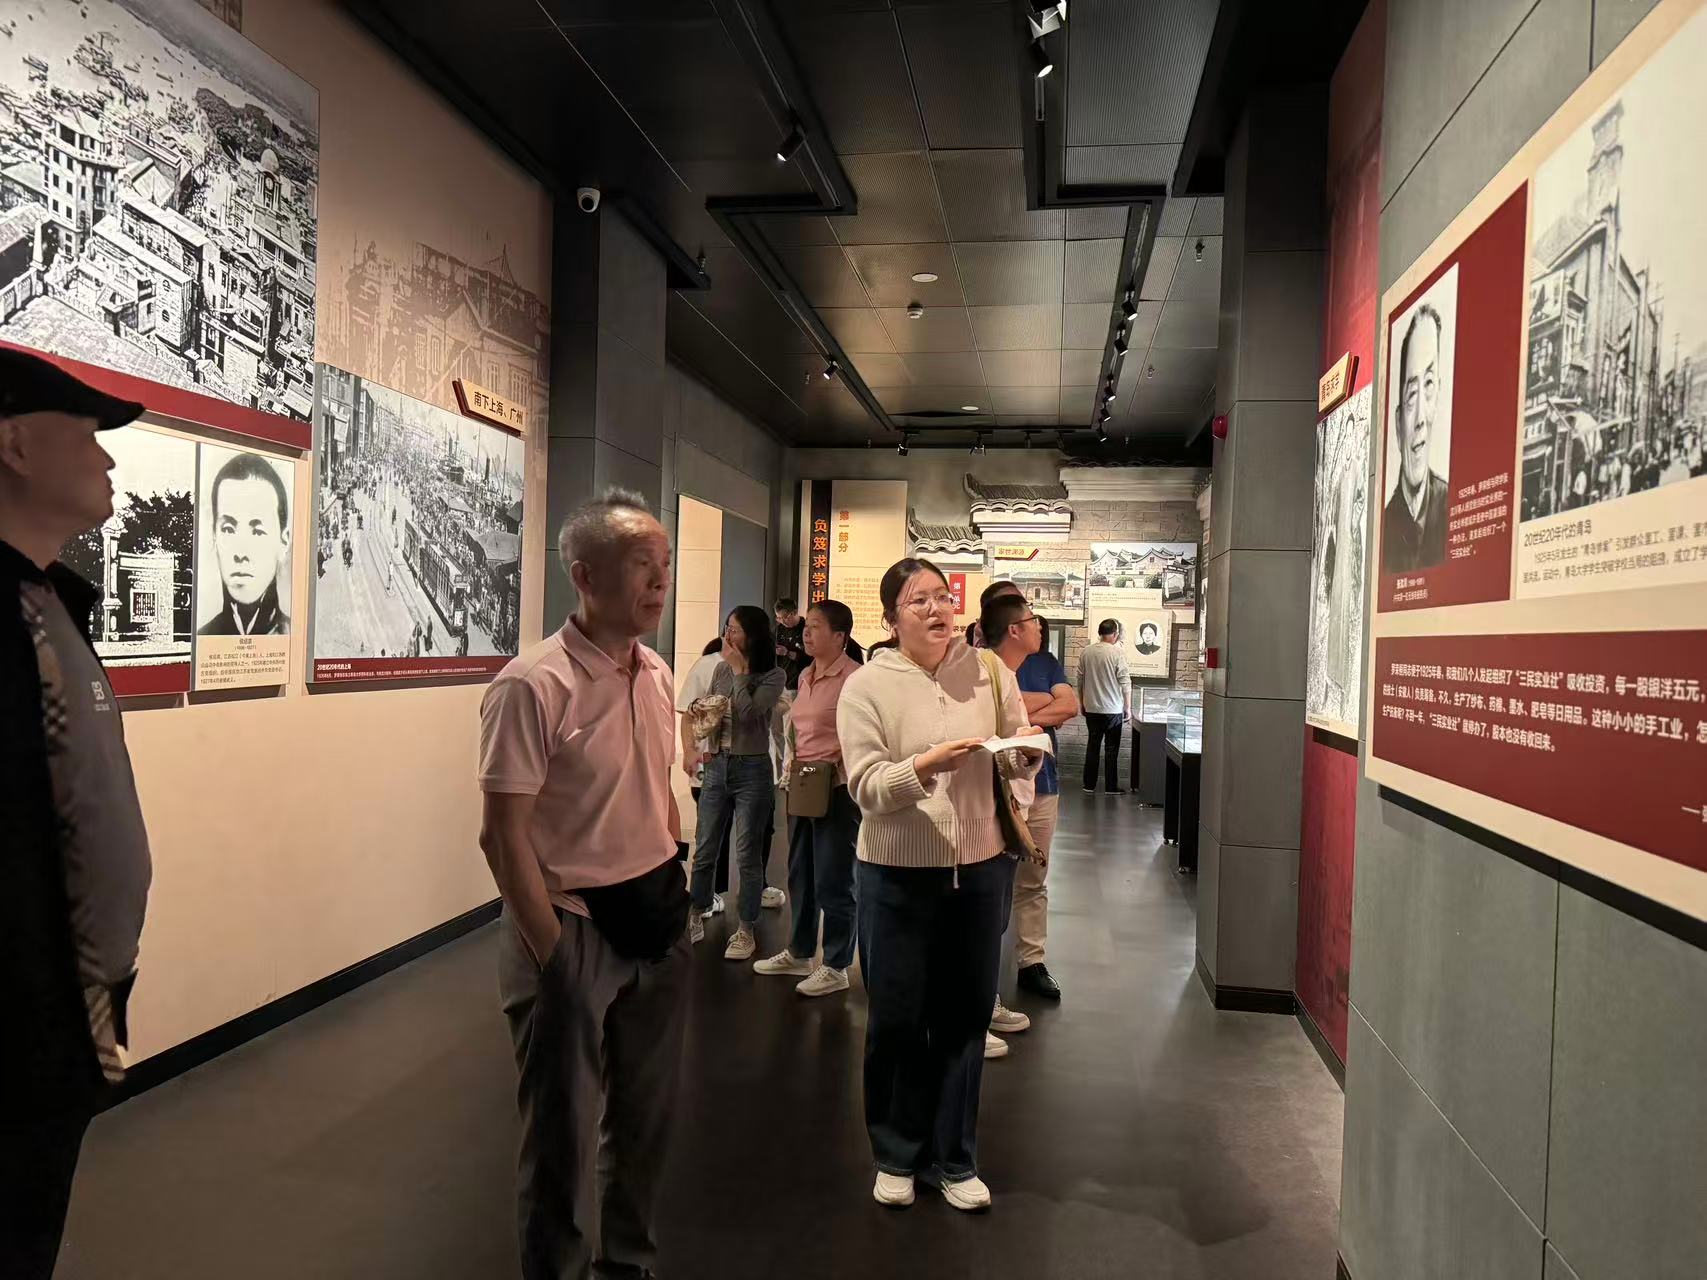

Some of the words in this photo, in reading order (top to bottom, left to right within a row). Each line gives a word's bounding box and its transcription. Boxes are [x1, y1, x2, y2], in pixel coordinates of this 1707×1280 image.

[474, 391, 524, 425] 南下上海、广州
[838, 511, 850, 553] 第一部分
[1524, 519, 1592, 547] 20世纪20年代的青岛
[811, 519, 828, 603] 负笈求学出
